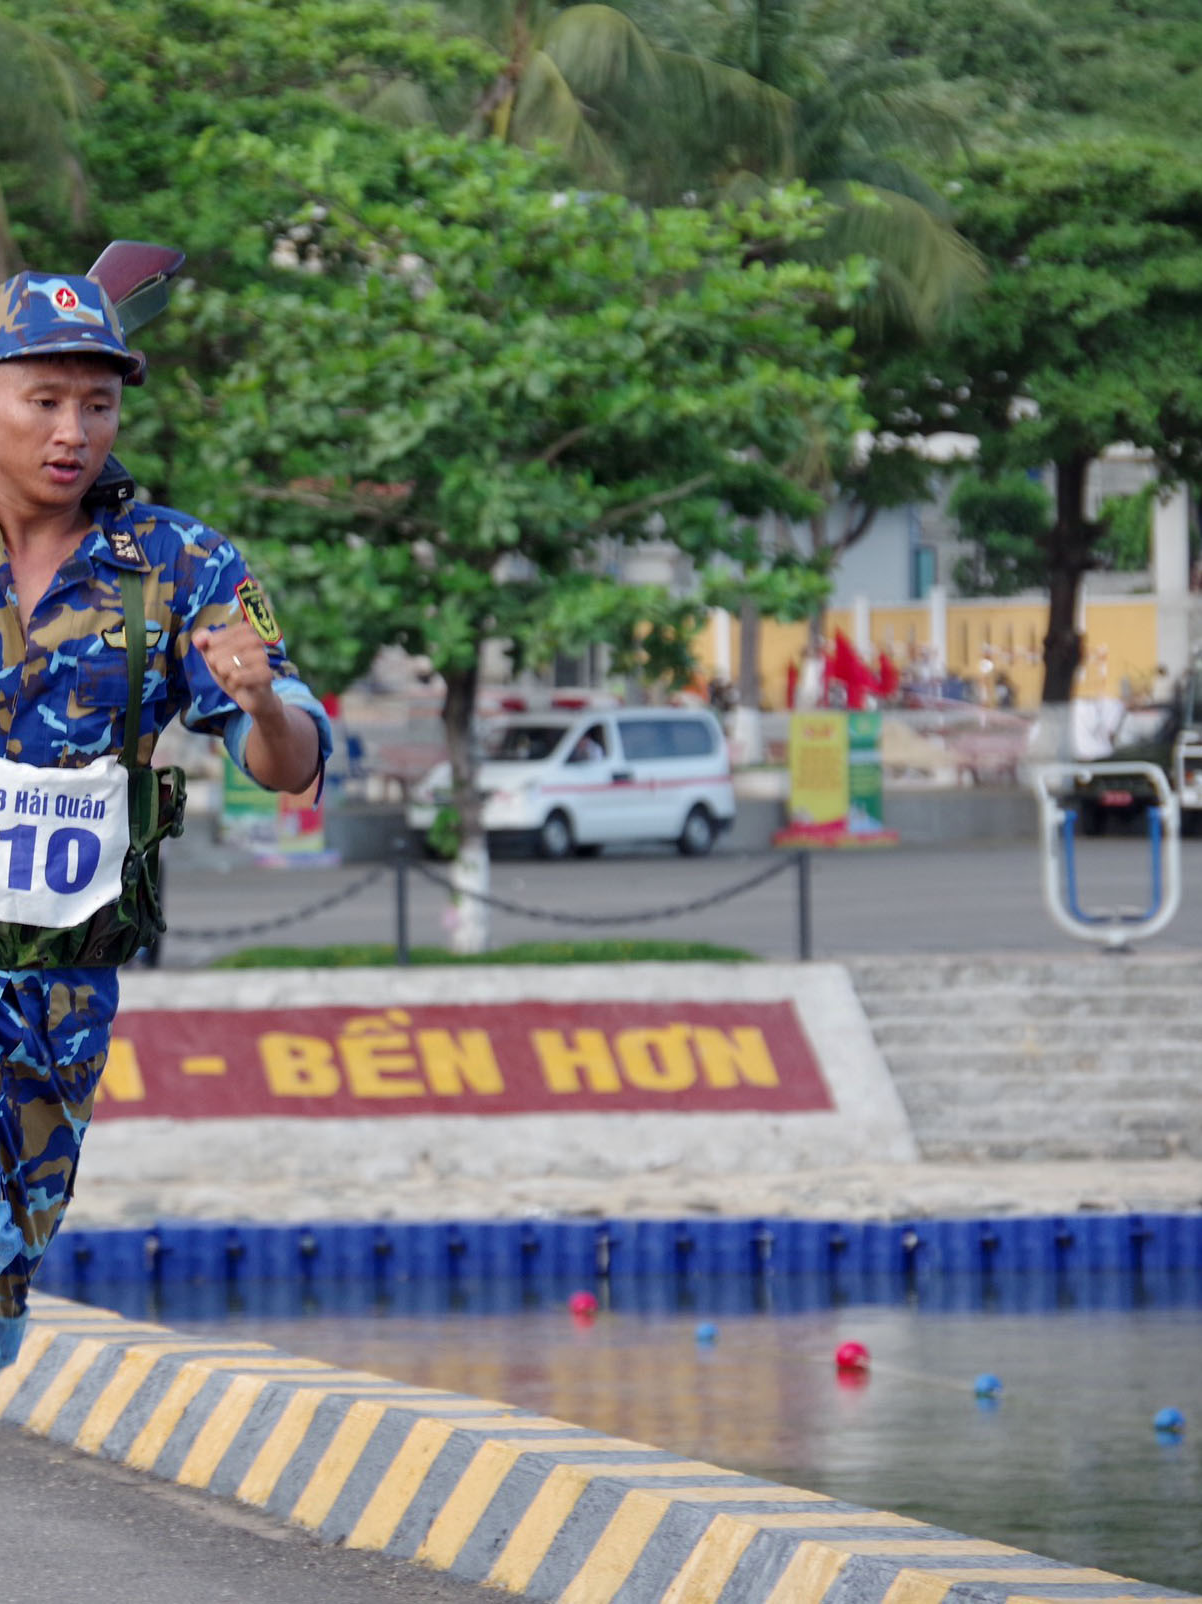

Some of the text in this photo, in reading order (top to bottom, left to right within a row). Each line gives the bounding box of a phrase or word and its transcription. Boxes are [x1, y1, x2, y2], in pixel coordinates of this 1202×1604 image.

[14, 787, 49, 816] Hải
[55, 794, 106, 820] Quân
[258, 1008, 505, 1098] BỀN
[532, 1022, 780, 1094] HƠN
